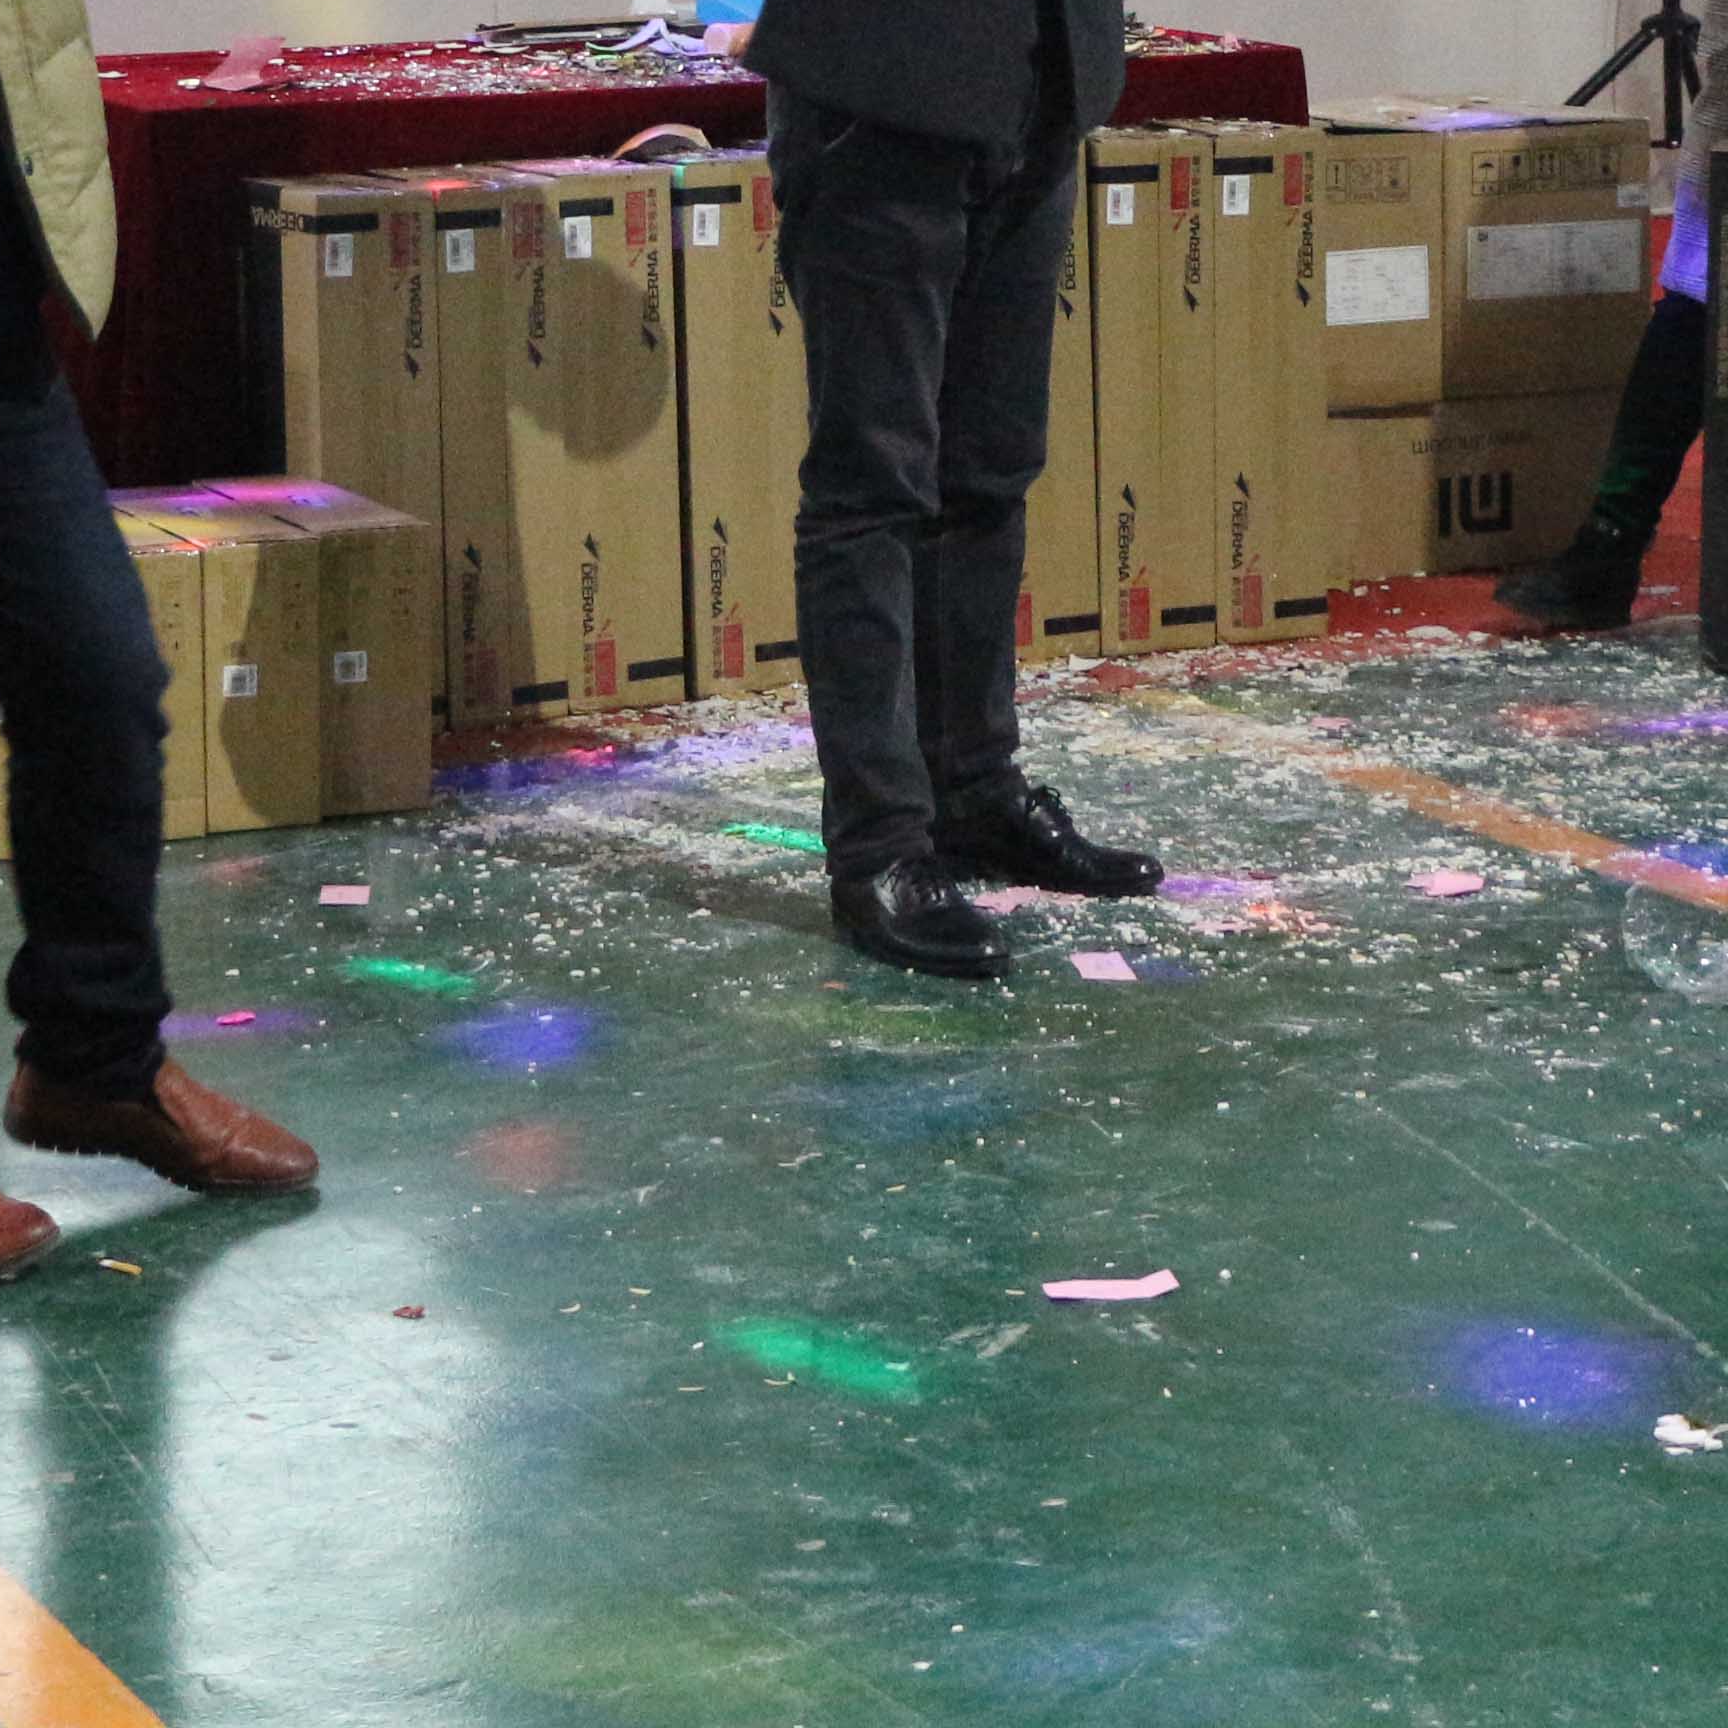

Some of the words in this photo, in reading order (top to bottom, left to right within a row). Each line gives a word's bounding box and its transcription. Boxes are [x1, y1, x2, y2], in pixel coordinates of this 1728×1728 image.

[1189, 215, 1201, 284] DEERMA
[1301, 209, 1313, 279] DEERMA
[408, 274, 421, 349] DEERMA
[533, 264, 545, 339] DEERMA
[647, 250, 660, 322] DEERMA
[1118, 512, 1130, 582] DEERMA
[1231, 500, 1243, 570] DEERMA
[581, 563, 594, 636] DEERMA
[710, 546, 723, 618] DEERMA
